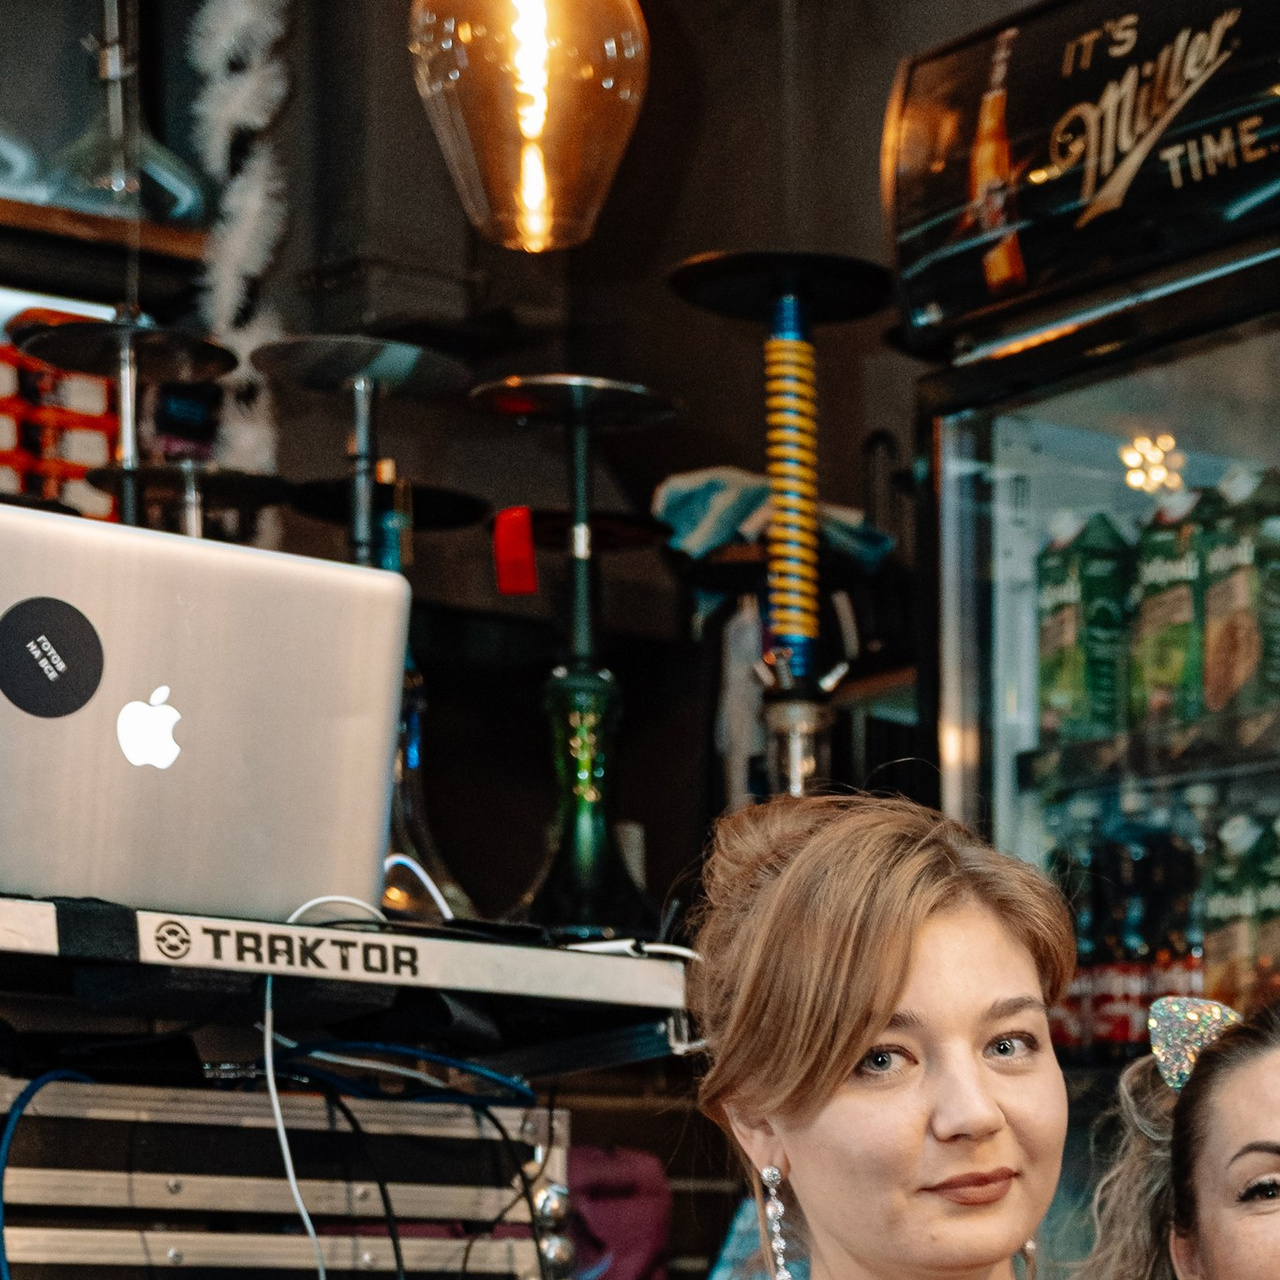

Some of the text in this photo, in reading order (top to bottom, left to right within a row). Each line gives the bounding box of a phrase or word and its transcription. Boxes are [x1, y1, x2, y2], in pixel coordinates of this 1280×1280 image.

[1062, 13, 1140, 78] IT'S
[1048, 8, 1244, 215] Miller
[36, 634, 67, 673] ГОТОВ
[202, 926, 420, 978] TRAKTOR
